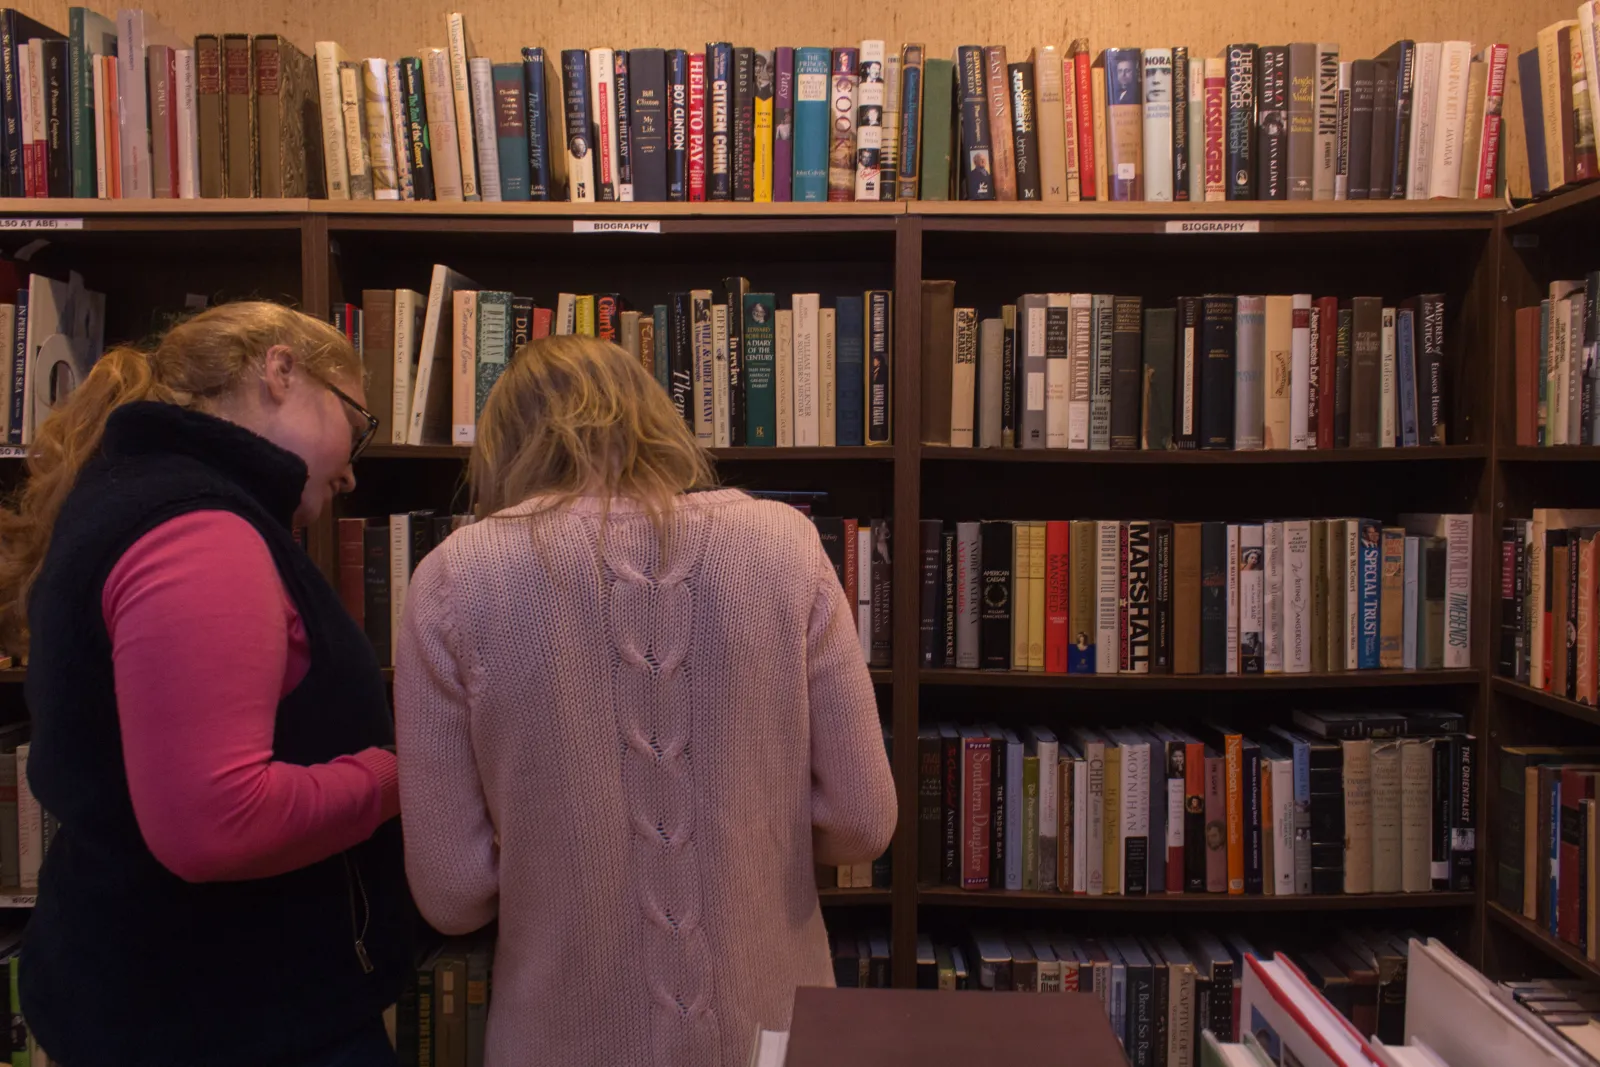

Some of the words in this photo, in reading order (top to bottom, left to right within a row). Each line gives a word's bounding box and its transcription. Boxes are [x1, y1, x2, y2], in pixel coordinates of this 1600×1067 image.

[451, 19, 460, 52] Winston
[990, 51, 1000, 81] LAST
[1145, 56, 1171, 65] NORA
[1231, 50, 1241, 65] OF
[1242, 50, 1252, 72] THE
[1275, 52, 1283, 67] MY
[1493, 48, 1507, 63] BOB
[452, 54, 464, 91] Churchill
[690, 61, 703, 104] HELL
[780, 72, 792, 99] Patsy
[966, 51, 974, 94] KENNEDY
[1231, 67, 1241, 108] POWER
[1264, 52, 1273, 103] CENTURY
[1491, 63, 1504, 95] KERREY
[408, 95, 418, 105] The
[529, 92, 539, 107] The
[618, 78, 627, 119] MADAME
[674, 84, 685, 105] BOY
[993, 85, 1005, 117] LION
[1013, 70, 1025, 133] JUDGMENT
[1242, 74, 1252, 107] PRICE
[1275, 72, 1283, 108] CRAZY
[1319, 52, 1337, 135] KOESTLER
[409, 108, 419, 121] Zeal
[600, 93, 608, 125] SEDUCTION
[643, 116, 653, 124] My
[691, 107, 703, 129] TO
[713, 80, 727, 132] CITIZEN
[742, 106, 751, 129] LOST
[412, 130, 421, 141] the
[529, 109, 540, 147] Provoked
[619, 121, 628, 157] HILLARY
[642, 125, 656, 133] Life
[674, 107, 685, 150] CLINTON
[1176, 102, 1185, 148] Remembers
[1206, 88, 1223, 184] KISSINGER
[1230, 123, 1241, 154] Hersh
[1240, 112, 1251, 160] Seymour
[414, 142, 423, 168] Convert
[530, 149, 541, 169] Wife
[690, 134, 703, 163] PAY
[713, 135, 727, 174] COHN
[1016, 136, 1025, 156] John
[1340, 138, 1348, 175] KOESTLER
[1443, 128, 1453, 166] JAYAKAR
[743, 136, 751, 189] CRUSADER
[1018, 156, 1027, 174] Kerr
[36, 220, 58, 228] ABE)
[1182, 223, 1244, 231] BIOGRAPHY
[19, 305, 26, 316] IN
[959, 311, 966, 324] OF
[1424, 302, 1433, 314] the
[18, 317, 26, 341] PERIL
[702, 324, 710, 347] WILL
[716, 309, 725, 344] EIFFEL
[965, 311, 973, 364] LAWRENCE
[1075, 309, 1089, 357] ABRAHAM
[1100, 307, 1112, 340] LINCOLN
[17, 343, 25, 356] ON
[702, 348, 711, 356] &
[730, 337, 738, 349] in
[958, 326, 966, 364] ARABIA
[1100, 342, 1112, 351] IN
[1434, 346, 1443, 356] of
[16, 359, 24, 375] THE
[703, 360, 711, 386] ARIEL
[730, 351, 740, 386] review
[1004, 370, 1010, 380] OF
[1100, 355, 1112, 368] THE
[1384, 354, 1393, 394] Madison
[15, 377, 23, 393] SEA
[1075, 360, 1088, 399] LINCOLN
[1099, 372, 1110, 395] TIMES
[1310, 367, 1320, 387] Lully
[704, 387, 712, 423] DURANT
[1101, 526, 1116, 562] STRAIGHT
[1450, 519, 1469, 554] ARTHUR
[1049, 554, 1058, 612] MANSFIELD
[1060, 554, 1068, 611] KATHERINE
[1101, 566, 1116, 575] ON
[1450, 556, 1469, 588] MILLER
[1101, 580, 1116, 593] TILL
[1130, 525, 1149, 670] MARSHALL
[1100, 597, 1116, 629] MORNING
[1449, 592, 1468, 649] TIMEBENDS
[1576, 547, 1590, 687] SOLZHENITSYN
[1462, 746, 1470, 763] THE
[973, 752, 990, 812] Southern
[1128, 750, 1137, 831] MOYNIHAN
[1462, 766, 1470, 822] ORIENTALIST
[968, 814, 989, 872] Daughter
[1139, 981, 1149, 989] A
[1180, 979, 1189, 988] A
[1138, 994, 1150, 1021] Breed
[1180, 988, 1189, 1037] CAPTIVE
[1139, 1024, 1149, 1038] So
[1180, 1039, 1189, 1053] OF
[1138, 1041, 1149, 1065] Rare
